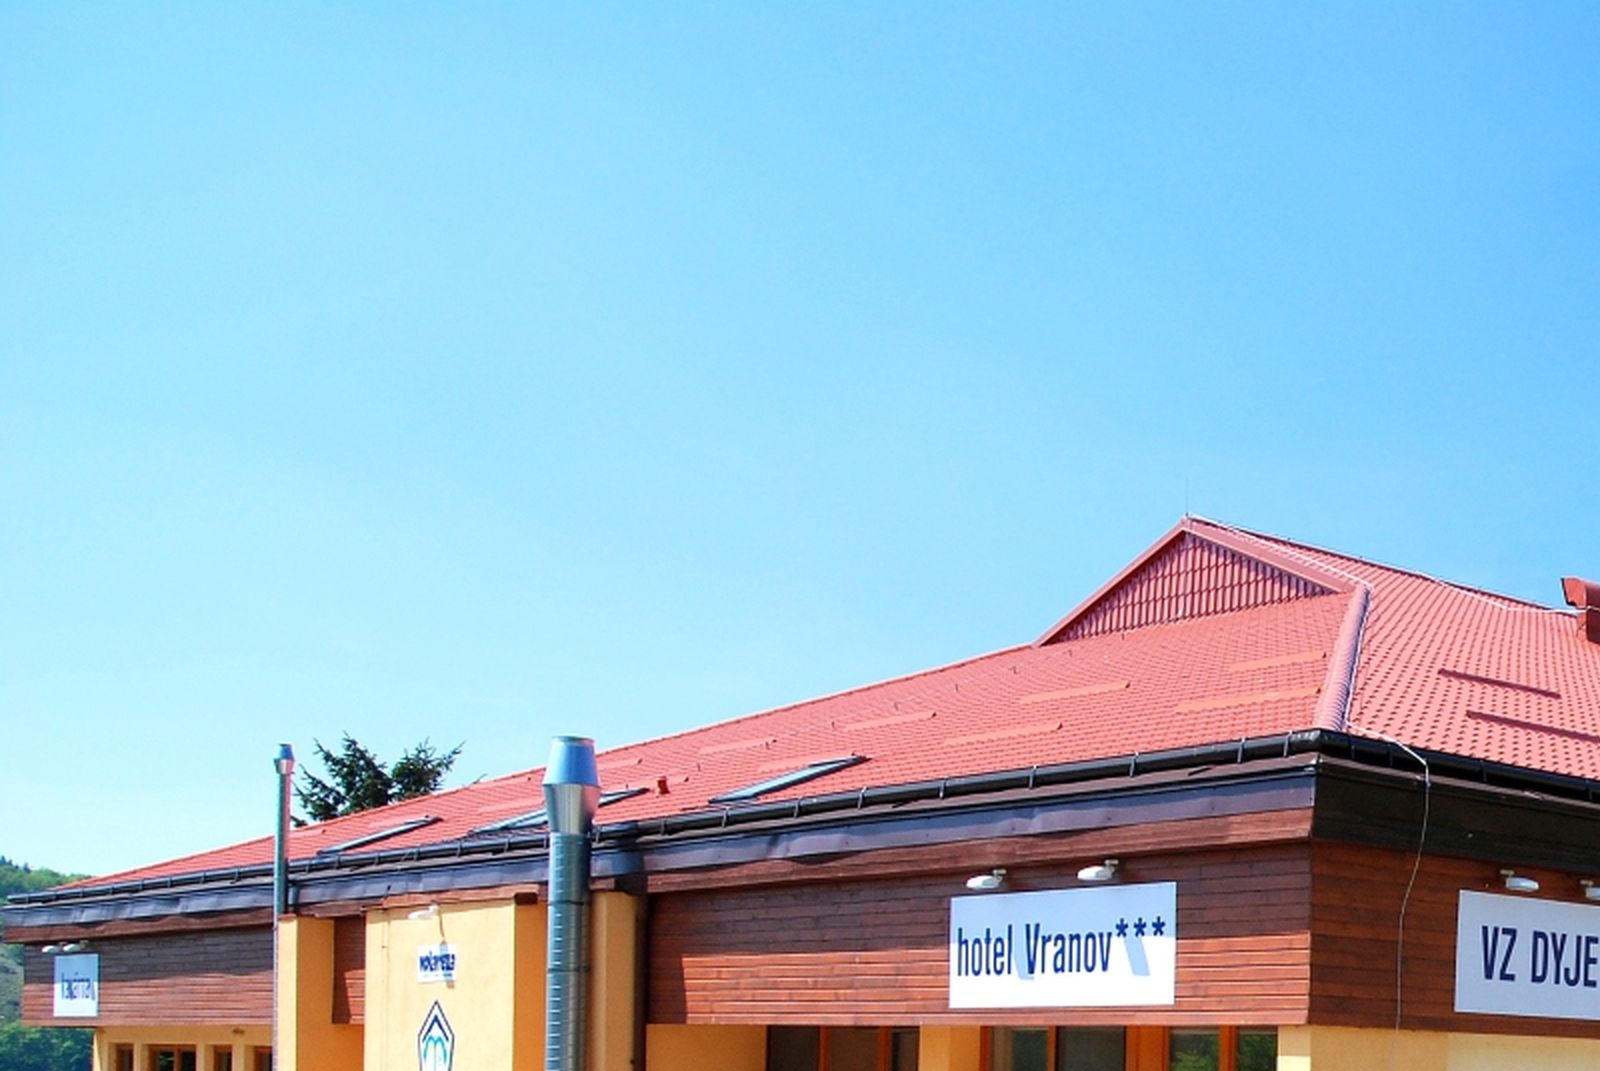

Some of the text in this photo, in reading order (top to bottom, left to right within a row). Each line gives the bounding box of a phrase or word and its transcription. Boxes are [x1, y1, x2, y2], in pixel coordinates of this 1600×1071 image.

[957, 924, 1012, 977] hotel
[1482, 925, 1599, 988] VZ DYJE
